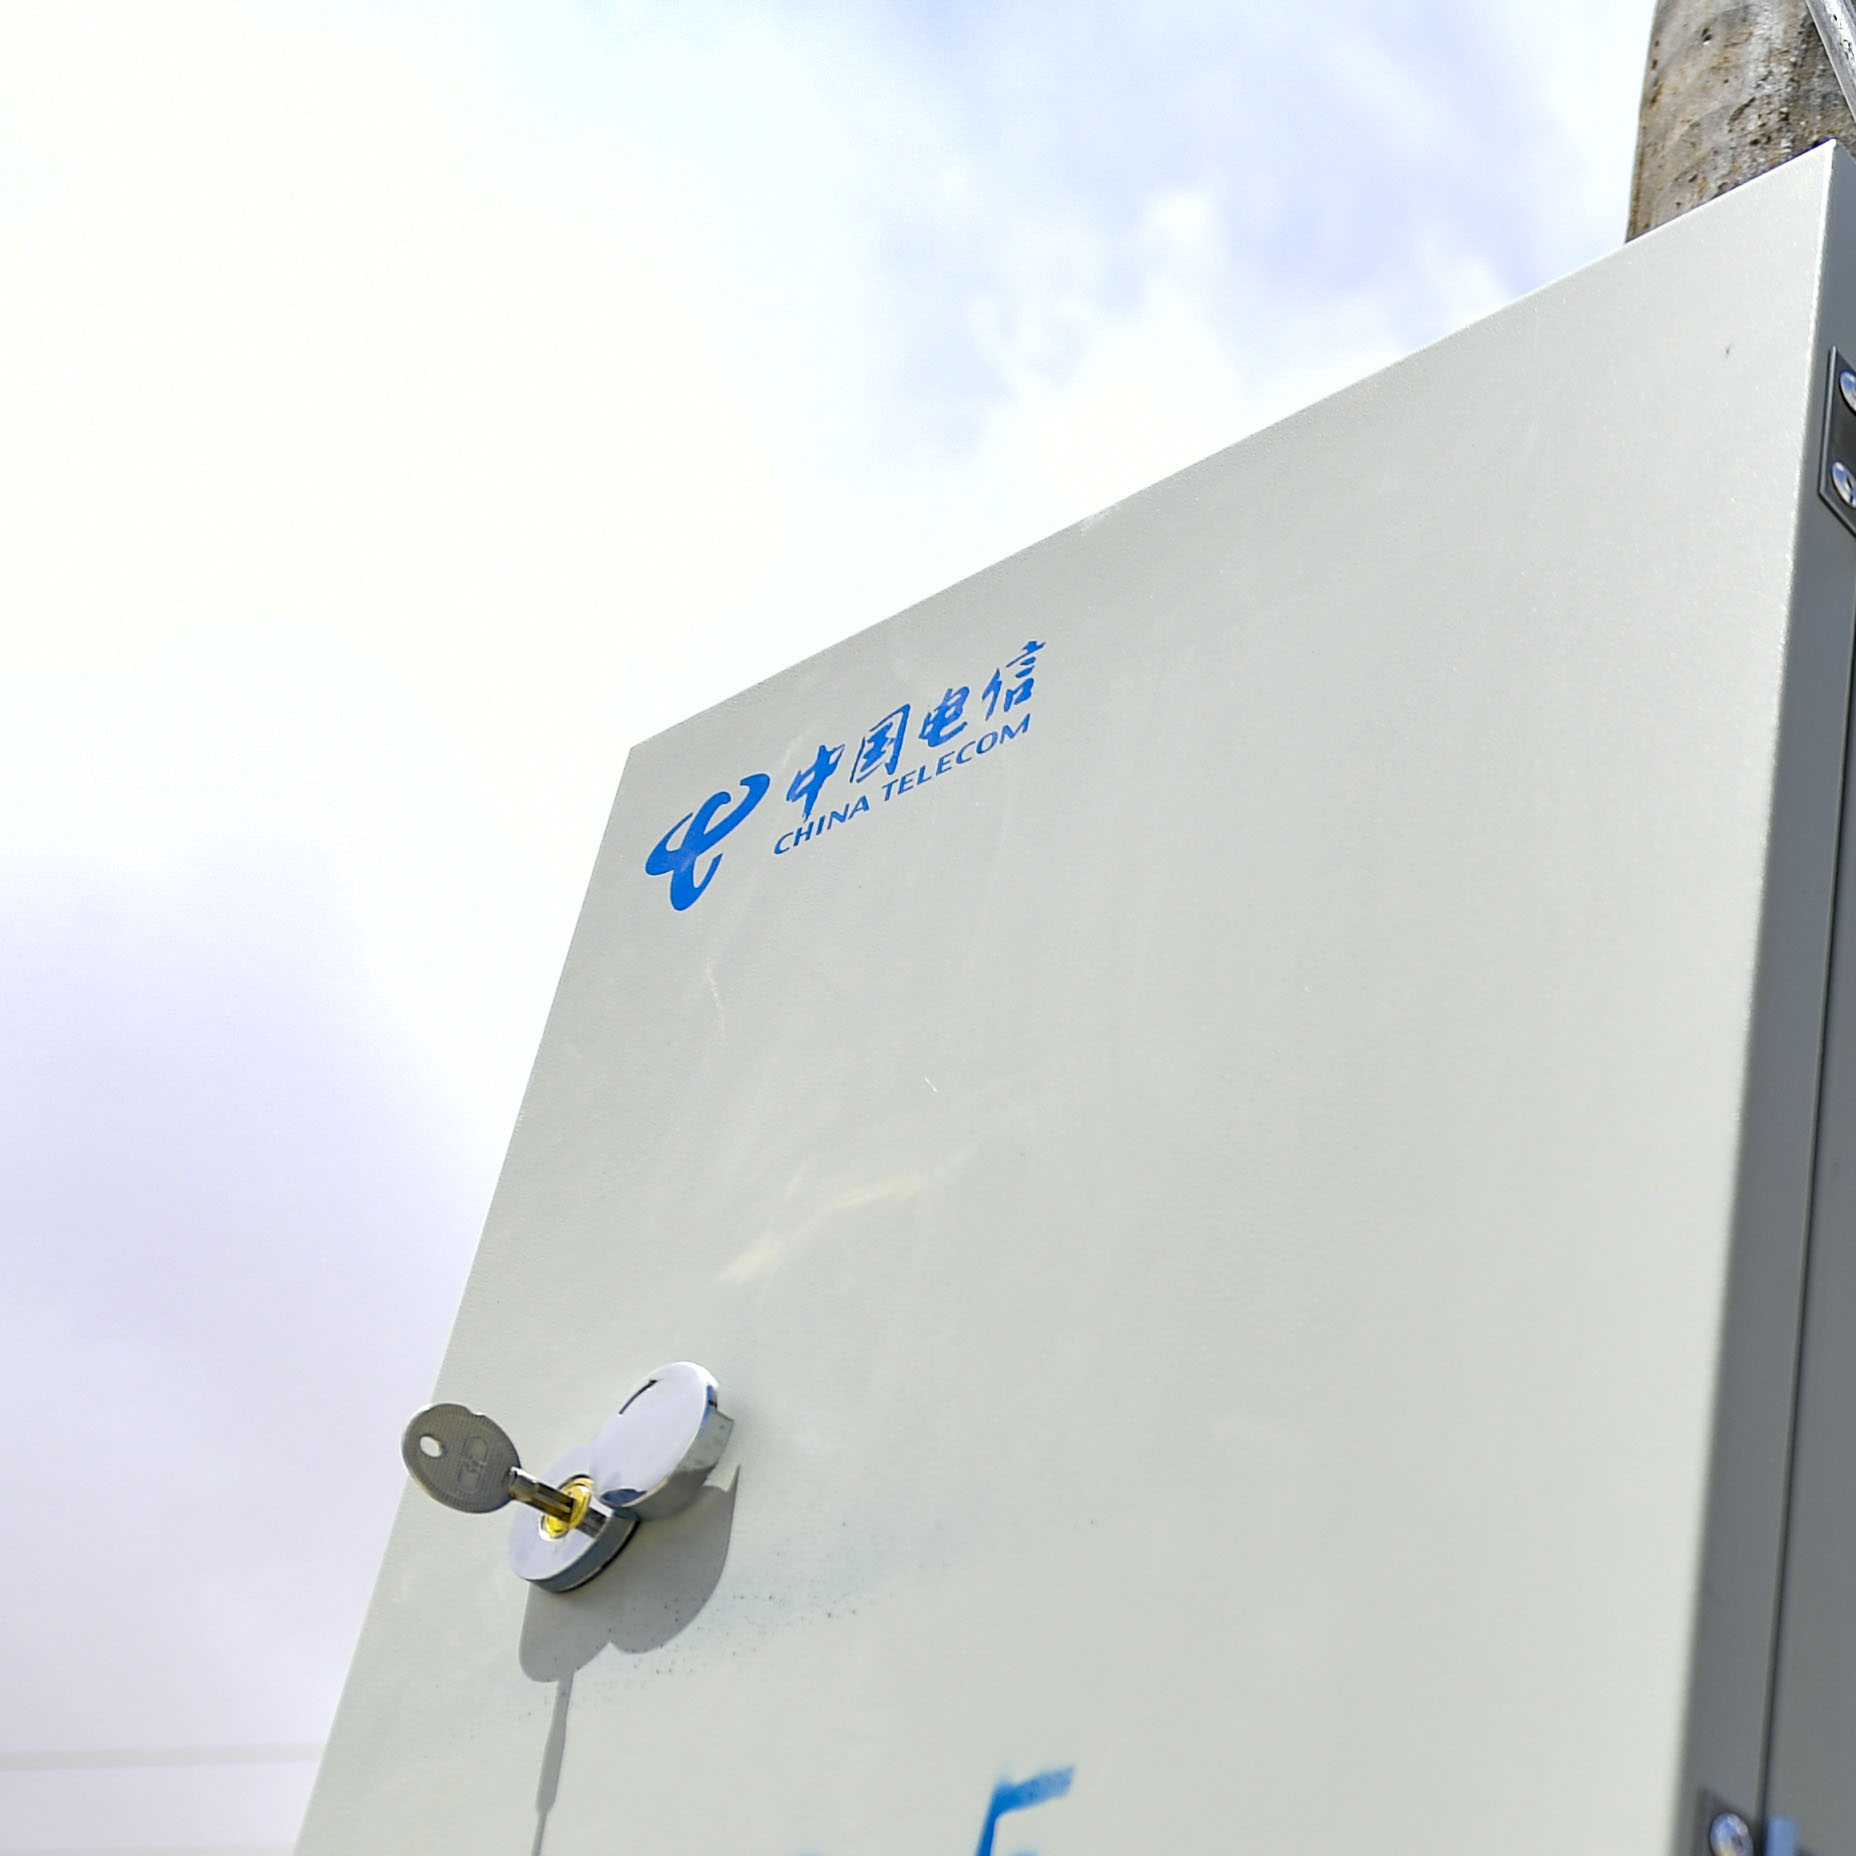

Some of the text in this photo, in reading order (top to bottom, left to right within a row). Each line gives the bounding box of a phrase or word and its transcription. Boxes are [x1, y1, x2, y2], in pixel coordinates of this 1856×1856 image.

[773, 714, 1032, 855] CHINA TELECOM
[786, 640, 1045, 821] 中国电信
